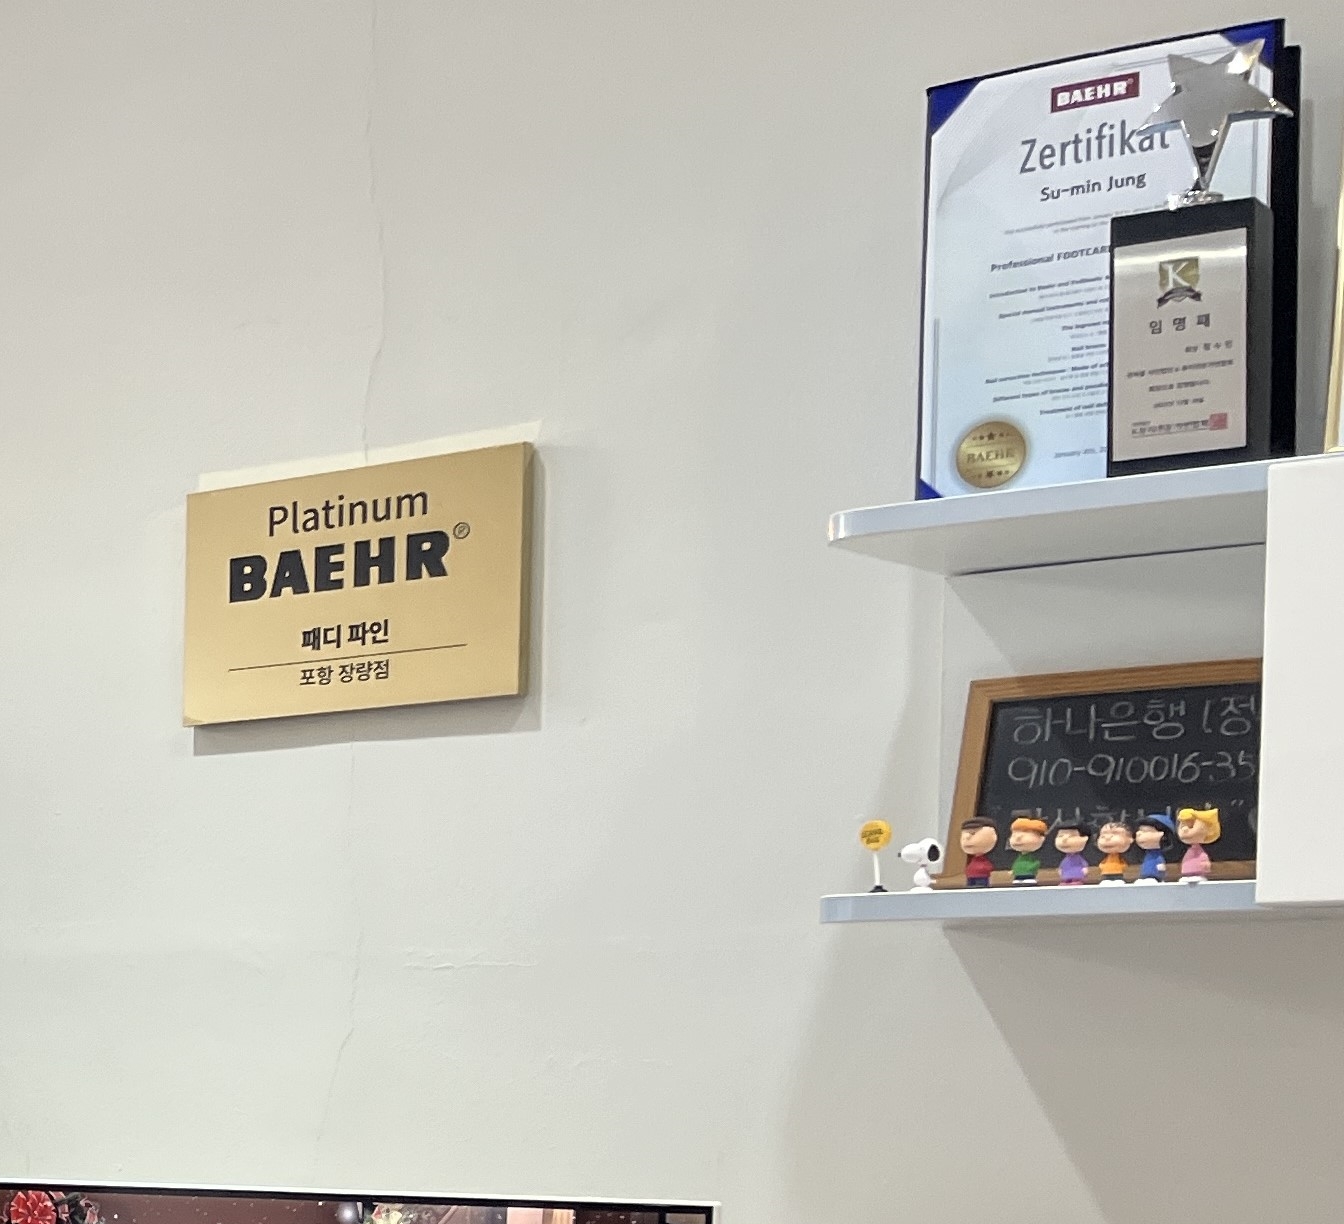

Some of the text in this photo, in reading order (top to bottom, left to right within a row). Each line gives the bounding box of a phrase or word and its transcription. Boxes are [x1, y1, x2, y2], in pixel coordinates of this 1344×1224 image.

[1019, 119, 1170, 174] Zertifikat
[1040, 173, 1147, 202] Su-min Jung
[991, 254, 1054, 272] Professional
[268, 491, 428, 537] Platinum
[302, 619, 390, 651] 패디 파인
[299, 659, 390, 686] 포항 장량점
[1012, 697, 1186, 745] 하나은행
